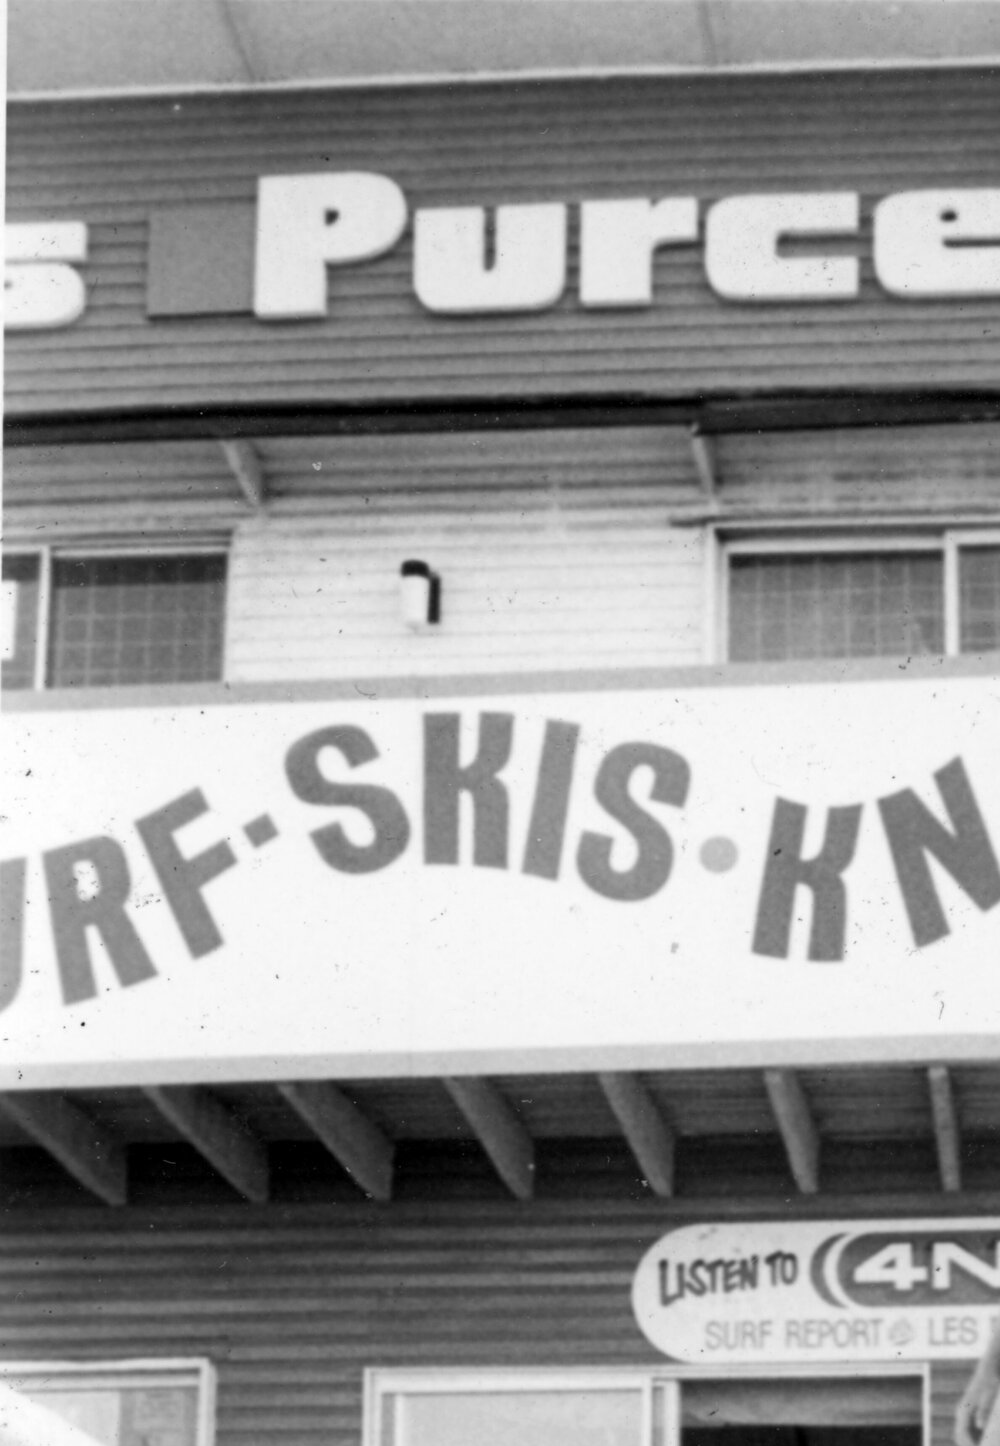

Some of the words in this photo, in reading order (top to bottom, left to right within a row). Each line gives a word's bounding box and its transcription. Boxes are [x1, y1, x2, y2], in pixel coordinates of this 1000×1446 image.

[284, 711, 692, 902] SKIS
[658, 1254, 759, 1307] LISTEN
[765, 1248, 799, 1286] TO
[705, 1320, 773, 1351] SURF
[785, 1317, 883, 1349] REPORT
[928, 1316, 979, 1347] LES
